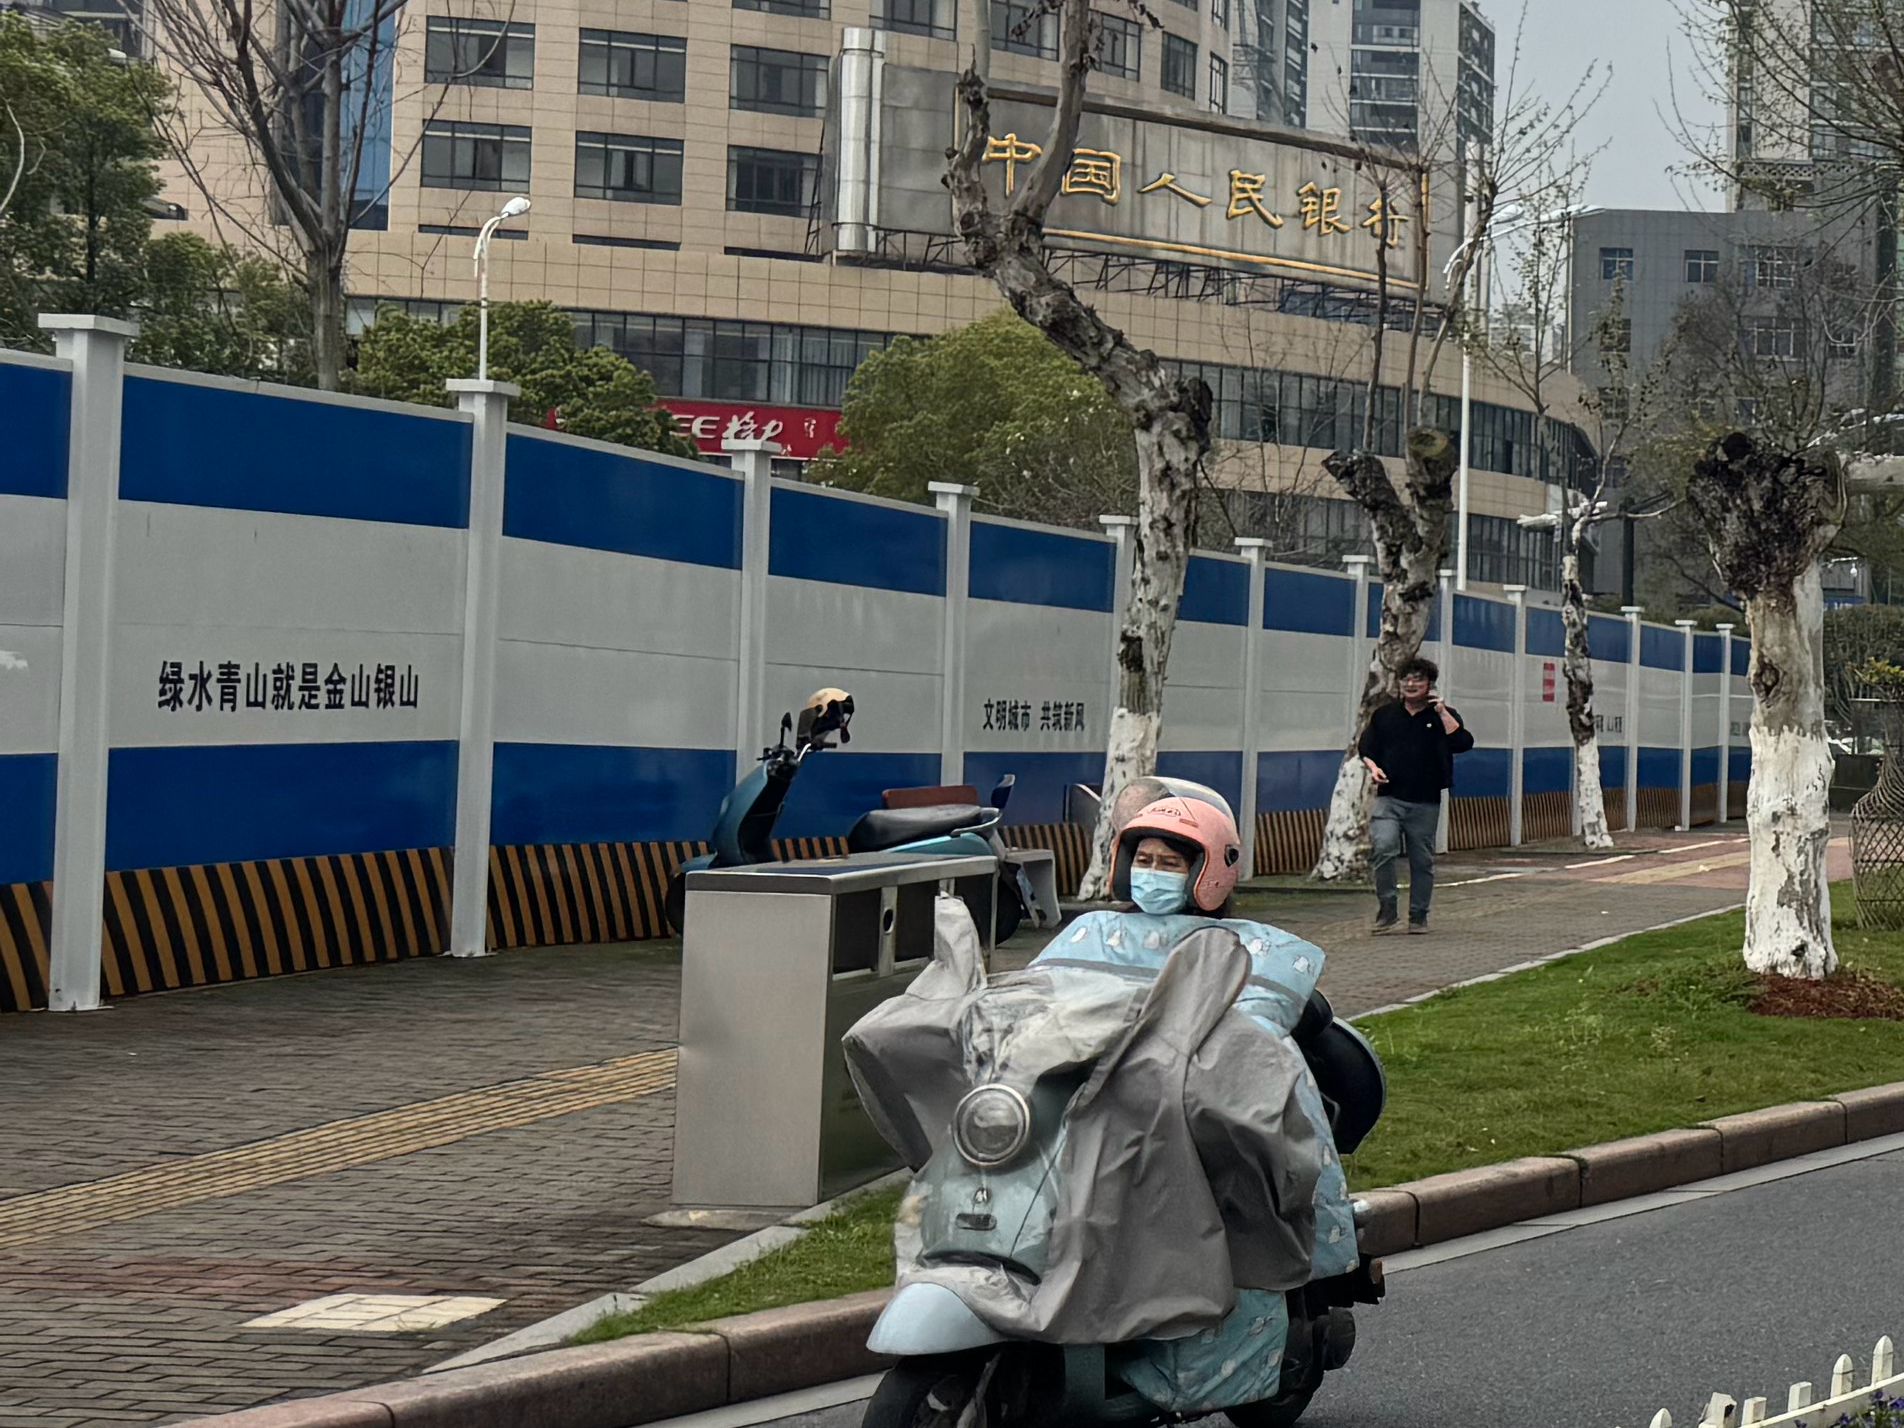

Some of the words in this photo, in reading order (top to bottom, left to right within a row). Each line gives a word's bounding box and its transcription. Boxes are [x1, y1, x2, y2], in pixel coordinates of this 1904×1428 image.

[981, 132, 1415, 248] 中国人民银行
[156, 659, 420, 714] 绿水青山就是金山银山
[982, 697, 1032, 732] 文明城市
[1040, 700, 1086, 732] 共筑新风
